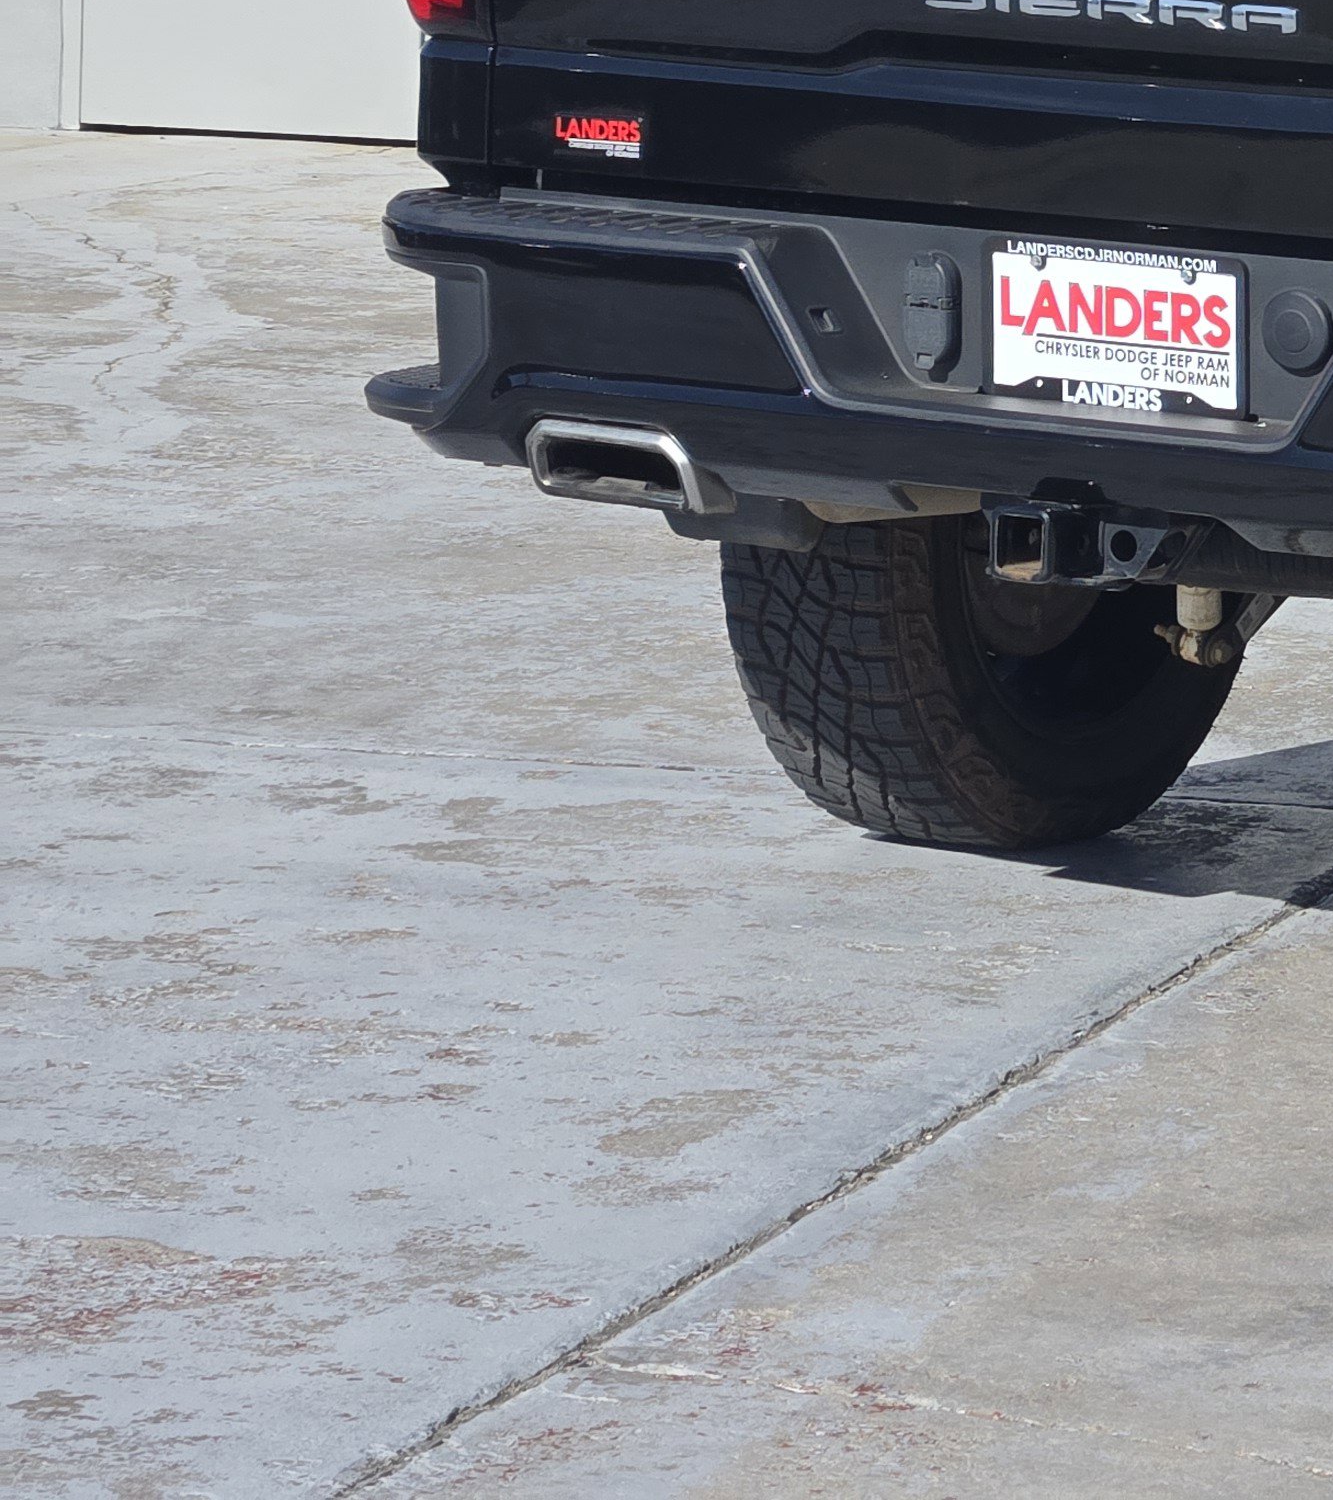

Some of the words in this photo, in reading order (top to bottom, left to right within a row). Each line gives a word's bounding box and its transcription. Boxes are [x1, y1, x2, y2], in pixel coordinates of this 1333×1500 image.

[556, 116, 640, 142] LANDERS
[1007, 240, 1216, 272] LANDERSCDJRNORMAN.COM
[1001, 276, 1230, 348] LANDERS
[1035, 340, 1100, 360] CHRYSLER
[1105, 348, 1157, 365] DODGE
[1162, 353, 1192, 369] JEEP
[1197, 356, 1229, 372] RAM
[1141, 367, 1159, 381] OF
[1165, 369, 1230, 388] NORMAN
[1062, 379, 1162, 412] LANDERS
